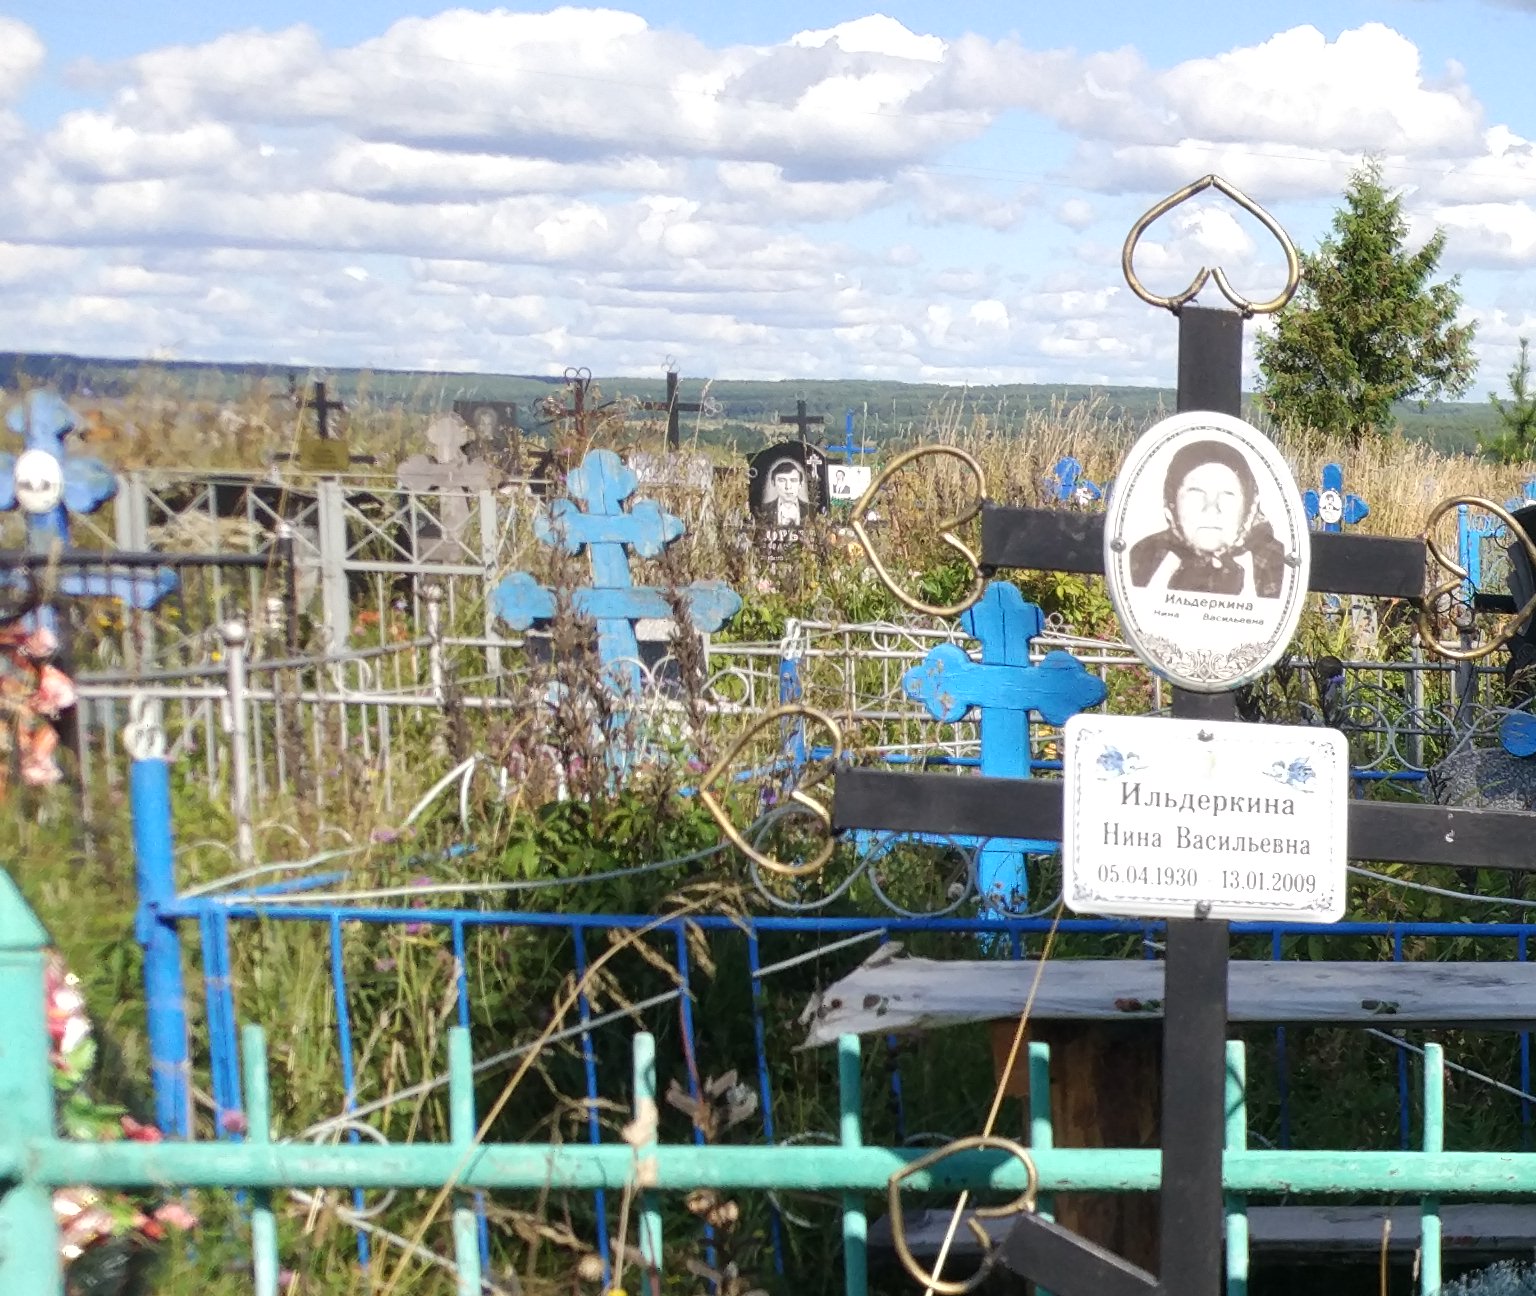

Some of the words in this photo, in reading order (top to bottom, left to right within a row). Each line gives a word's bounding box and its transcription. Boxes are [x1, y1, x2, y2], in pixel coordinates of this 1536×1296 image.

[1165, 593, 1253, 611] Ильдеркина
[1120, 781, 1295, 816] Ильдеркина
[1103, 822, 1162, 849] Нина
[1176, 826, 1311, 855] Васильевна
[1098, 864, 1198, 887] 05.04.1930
[1222, 870, 1316, 895] 13.01.2009
